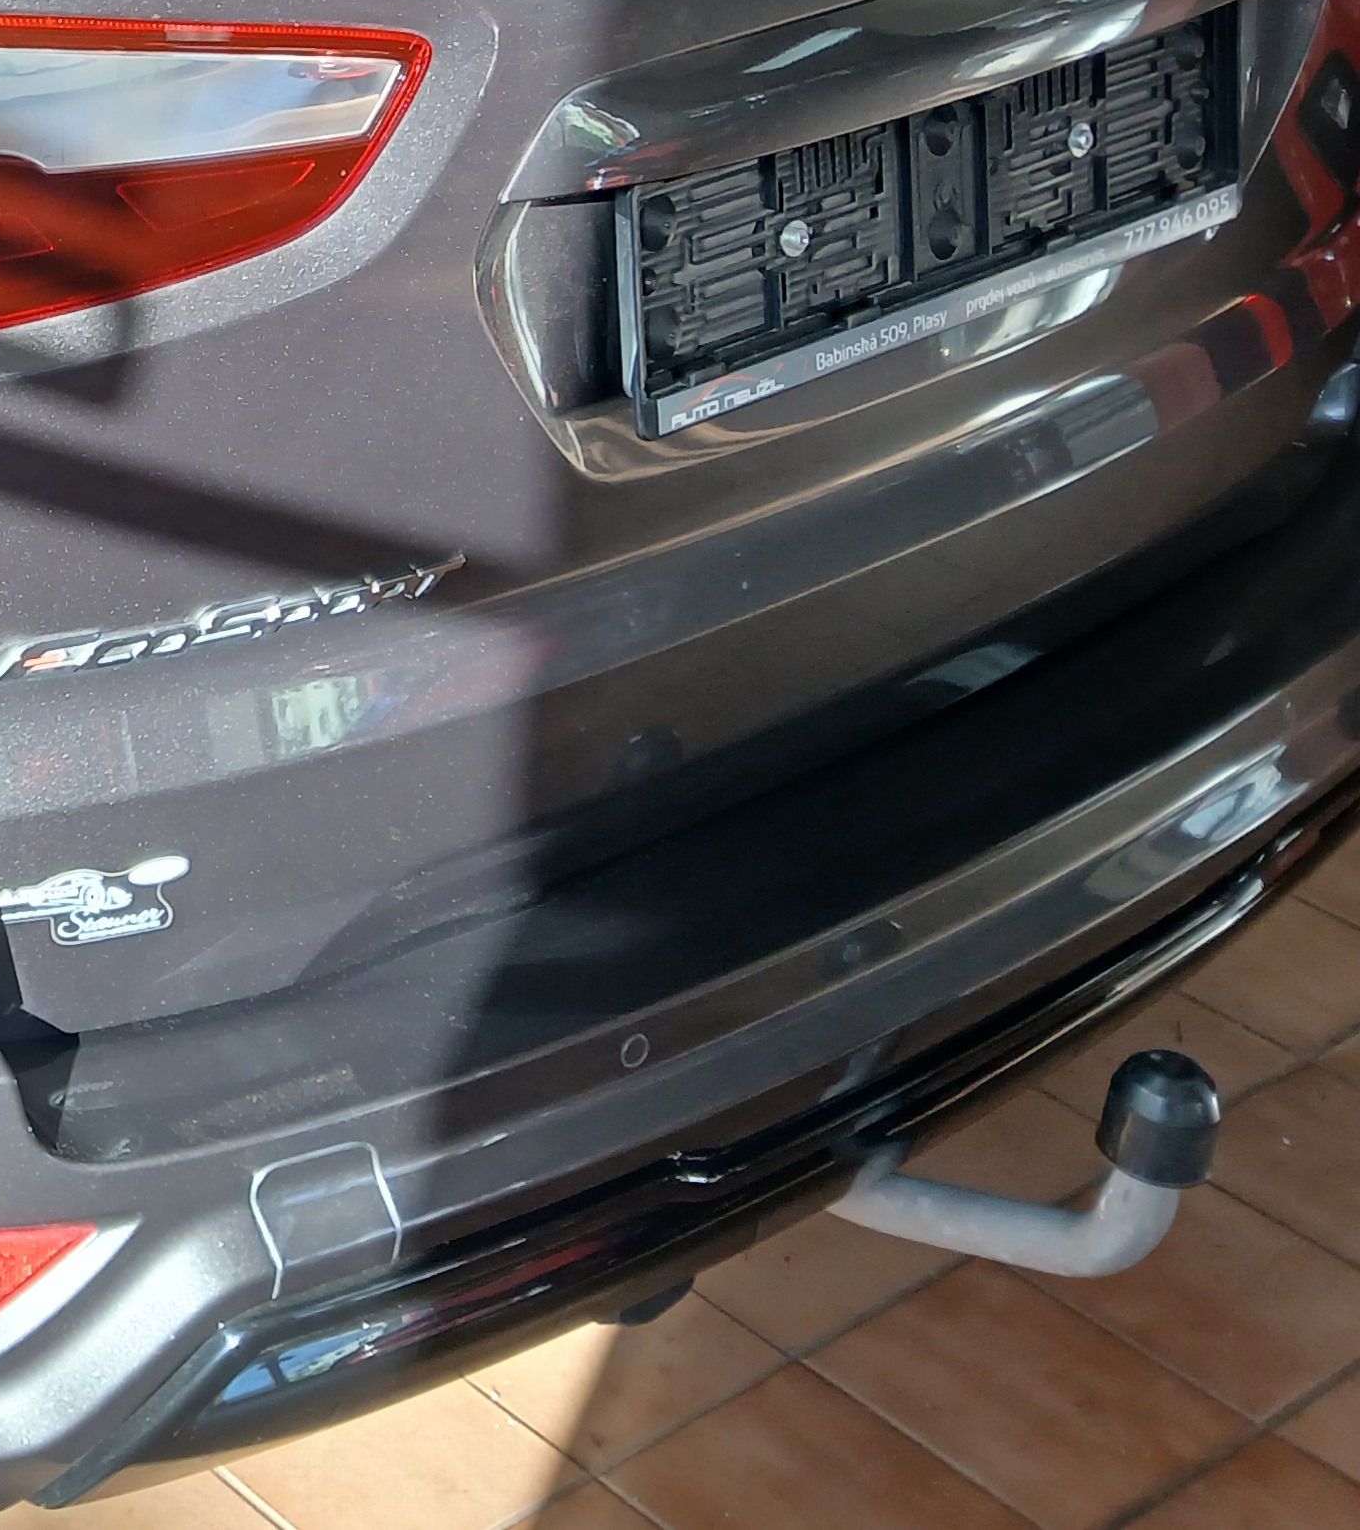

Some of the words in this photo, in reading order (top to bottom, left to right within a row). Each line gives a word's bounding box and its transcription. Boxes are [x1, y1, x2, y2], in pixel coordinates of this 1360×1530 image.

[1123, 222, 1156, 251] 777
[1159, 209, 1194, 236] 946
[1196, 195, 1231, 222] 095
[815, 332, 878, 372] Babinská
[879, 325, 911, 347] 509,
[912, 311, 949, 336] Plasy
[671, 399, 720, 431] AUTO
